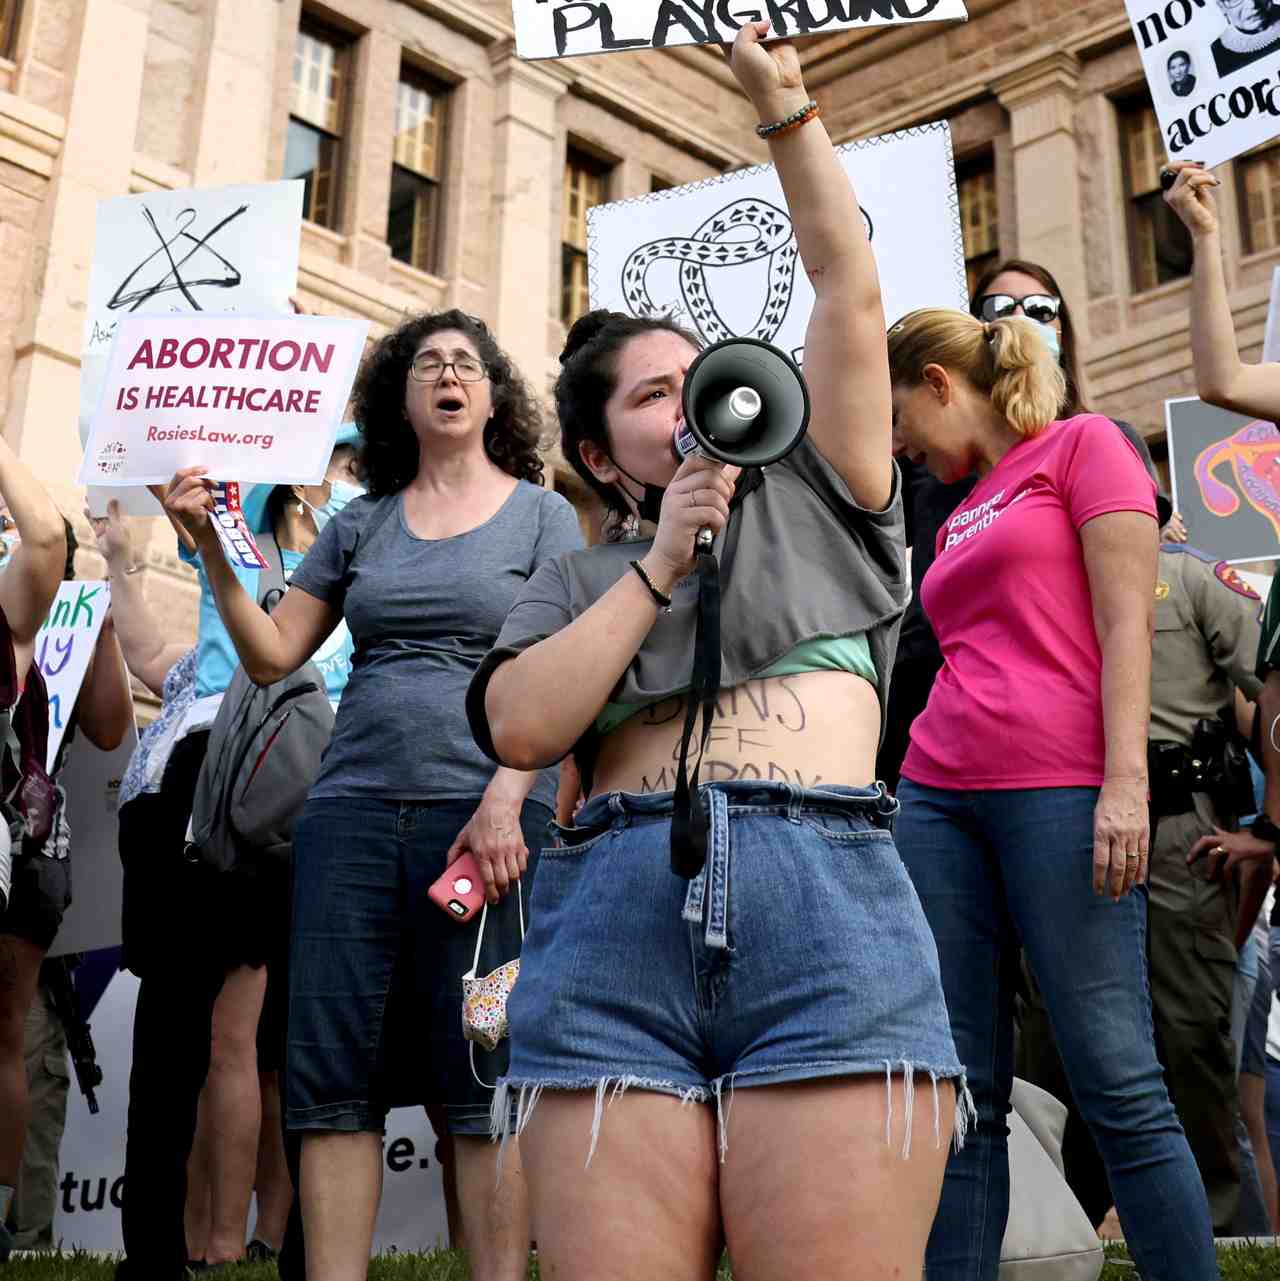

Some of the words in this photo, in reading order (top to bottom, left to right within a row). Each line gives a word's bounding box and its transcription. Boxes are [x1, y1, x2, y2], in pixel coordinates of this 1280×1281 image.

[127, 337, 335, 373] ABORTION
[117, 387, 140, 410] IS
[145, 385, 321, 413] HEALTHCARE
[146, 425, 273, 449] RosiesLaw.org
